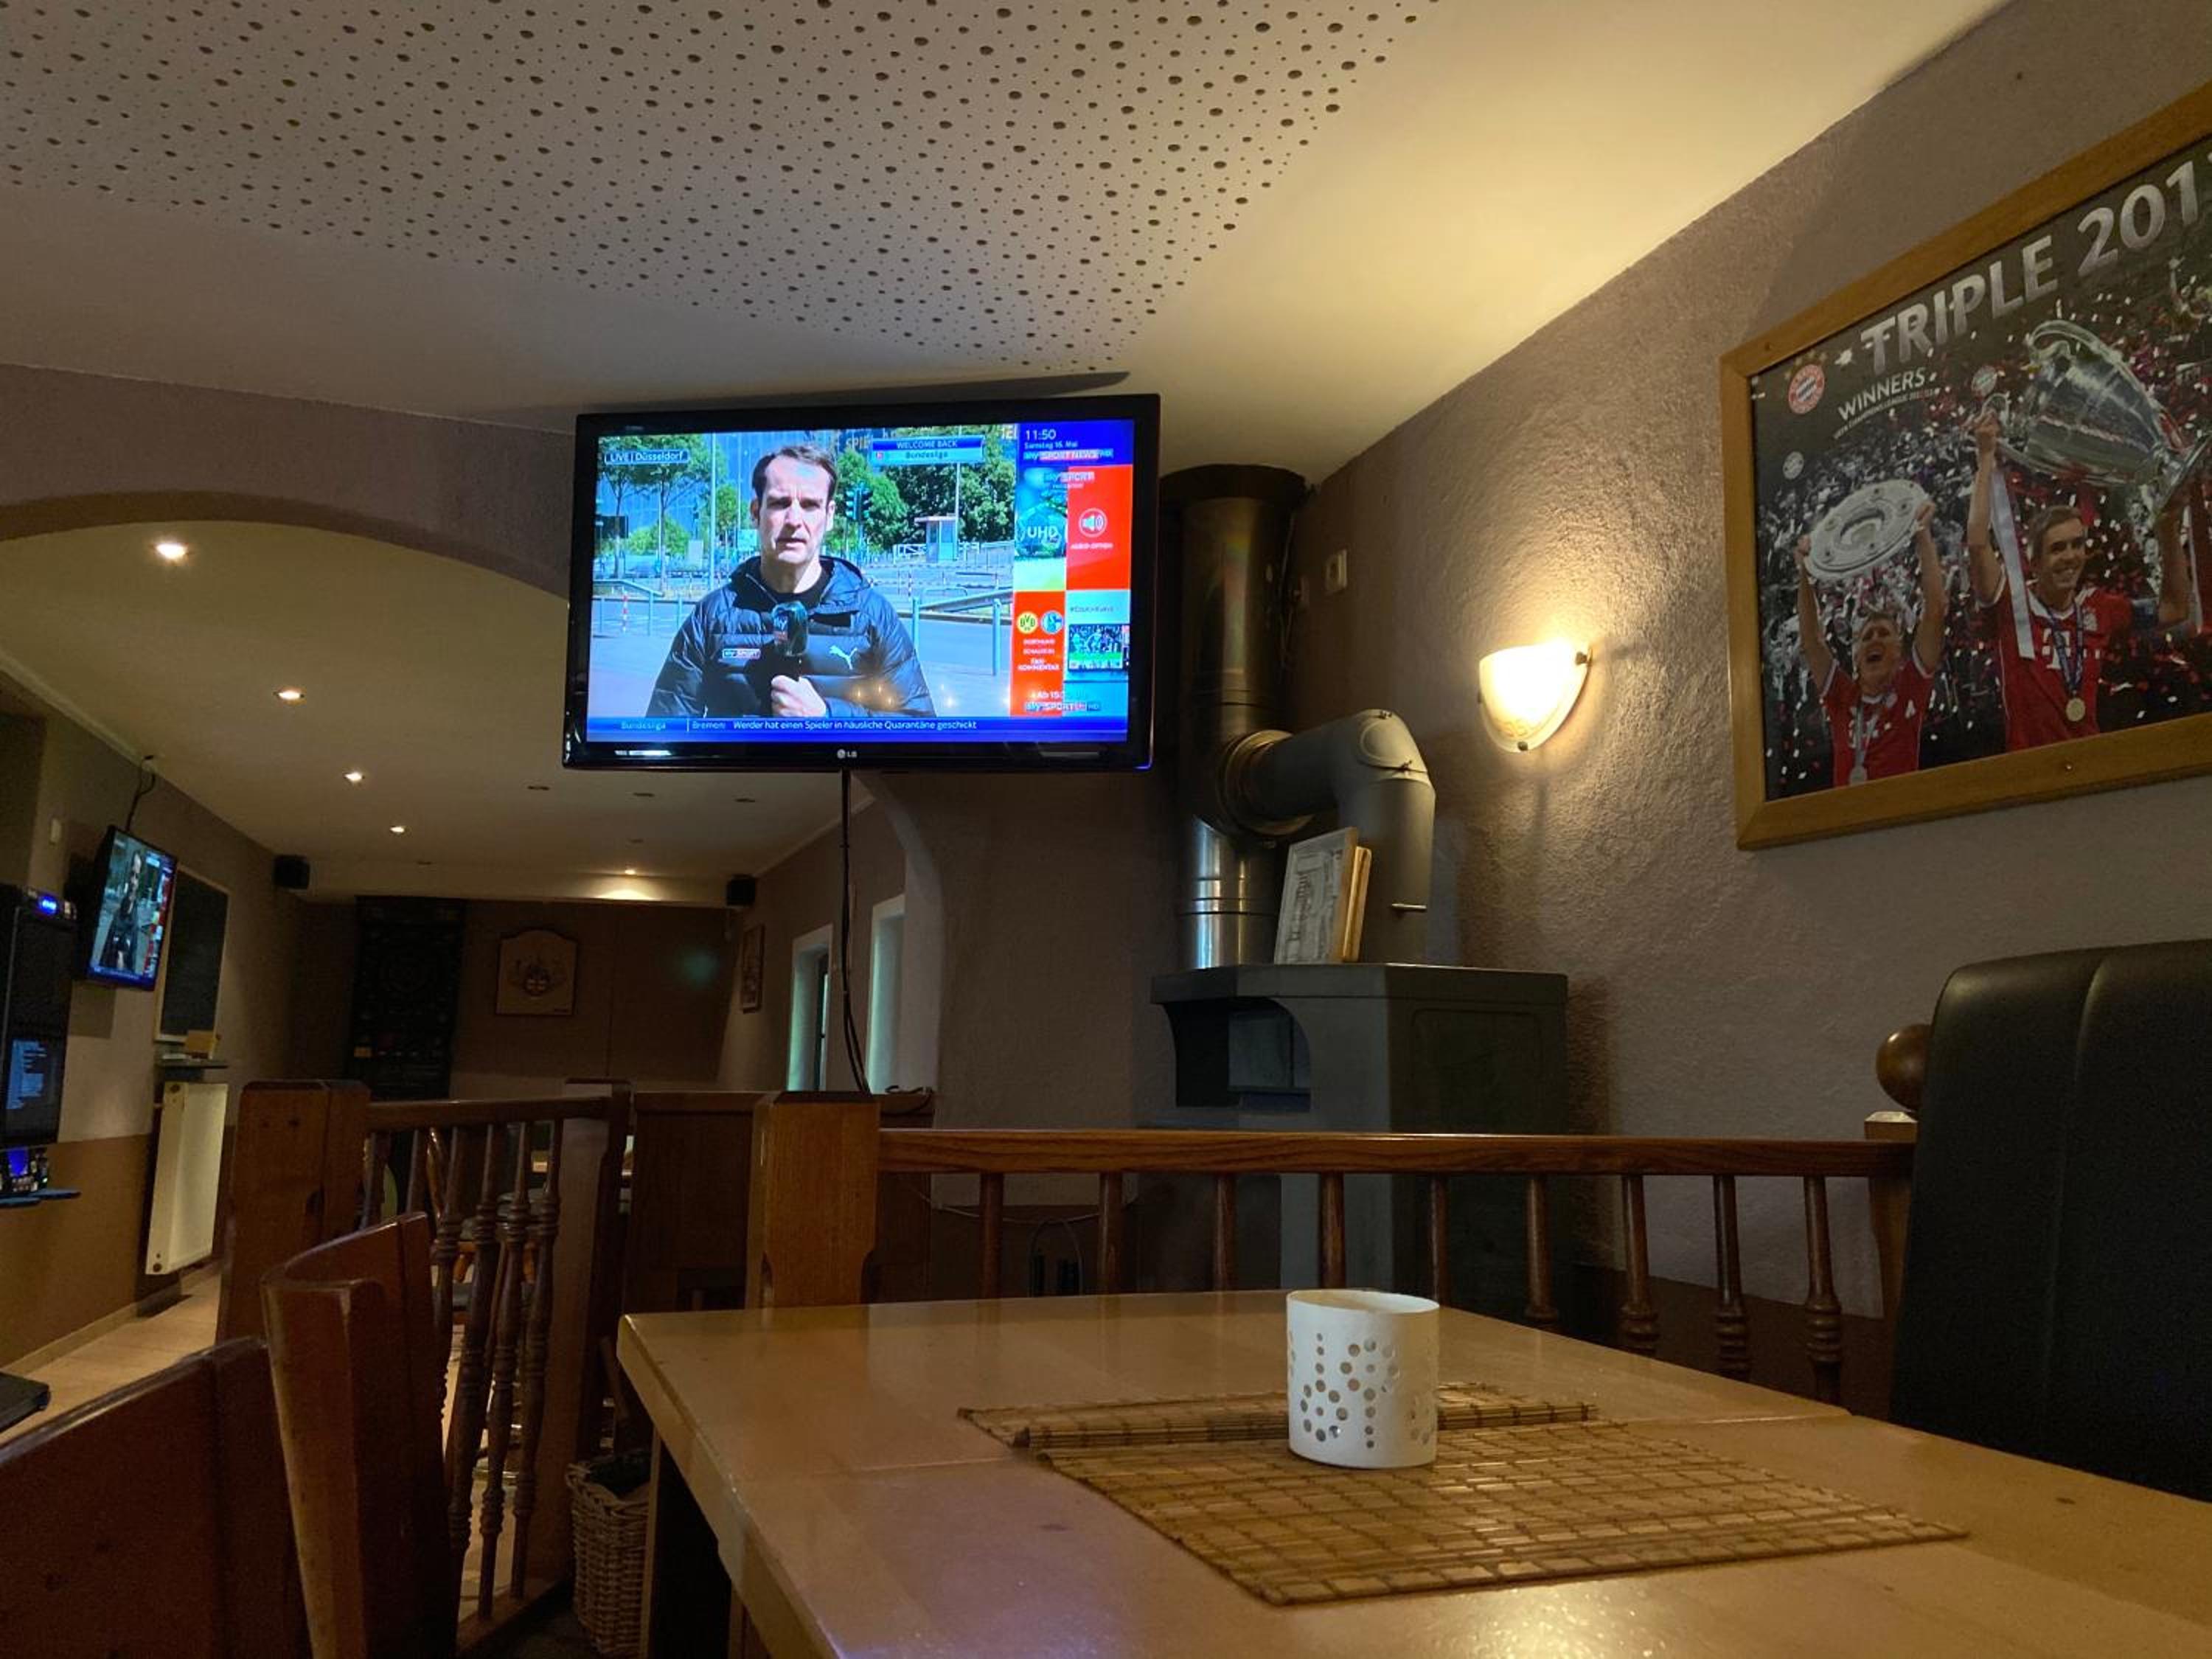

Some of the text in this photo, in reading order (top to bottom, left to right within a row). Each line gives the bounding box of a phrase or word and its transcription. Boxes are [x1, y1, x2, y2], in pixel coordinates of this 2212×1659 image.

[1860, 151, 2212, 375] TRIPLE 201
[1838, 367, 1927, 421] WINNERS
[1026, 428, 1057, 441] 11:50
[897, 439, 958, 450] WELCOME BACK
[610, 450, 684, 462] LIVE Düsseldorf
[1027, 524, 1058, 538] UHD
[733, 720, 764, 730] Werder
[764, 720, 779, 730] hat
[779, 721, 805, 730] einen
[804, 720, 833, 731] Spieler
[834, 720, 843, 730] in
[884, 720, 936, 730] Quarantäne
[936, 720, 977, 731] geschickt
